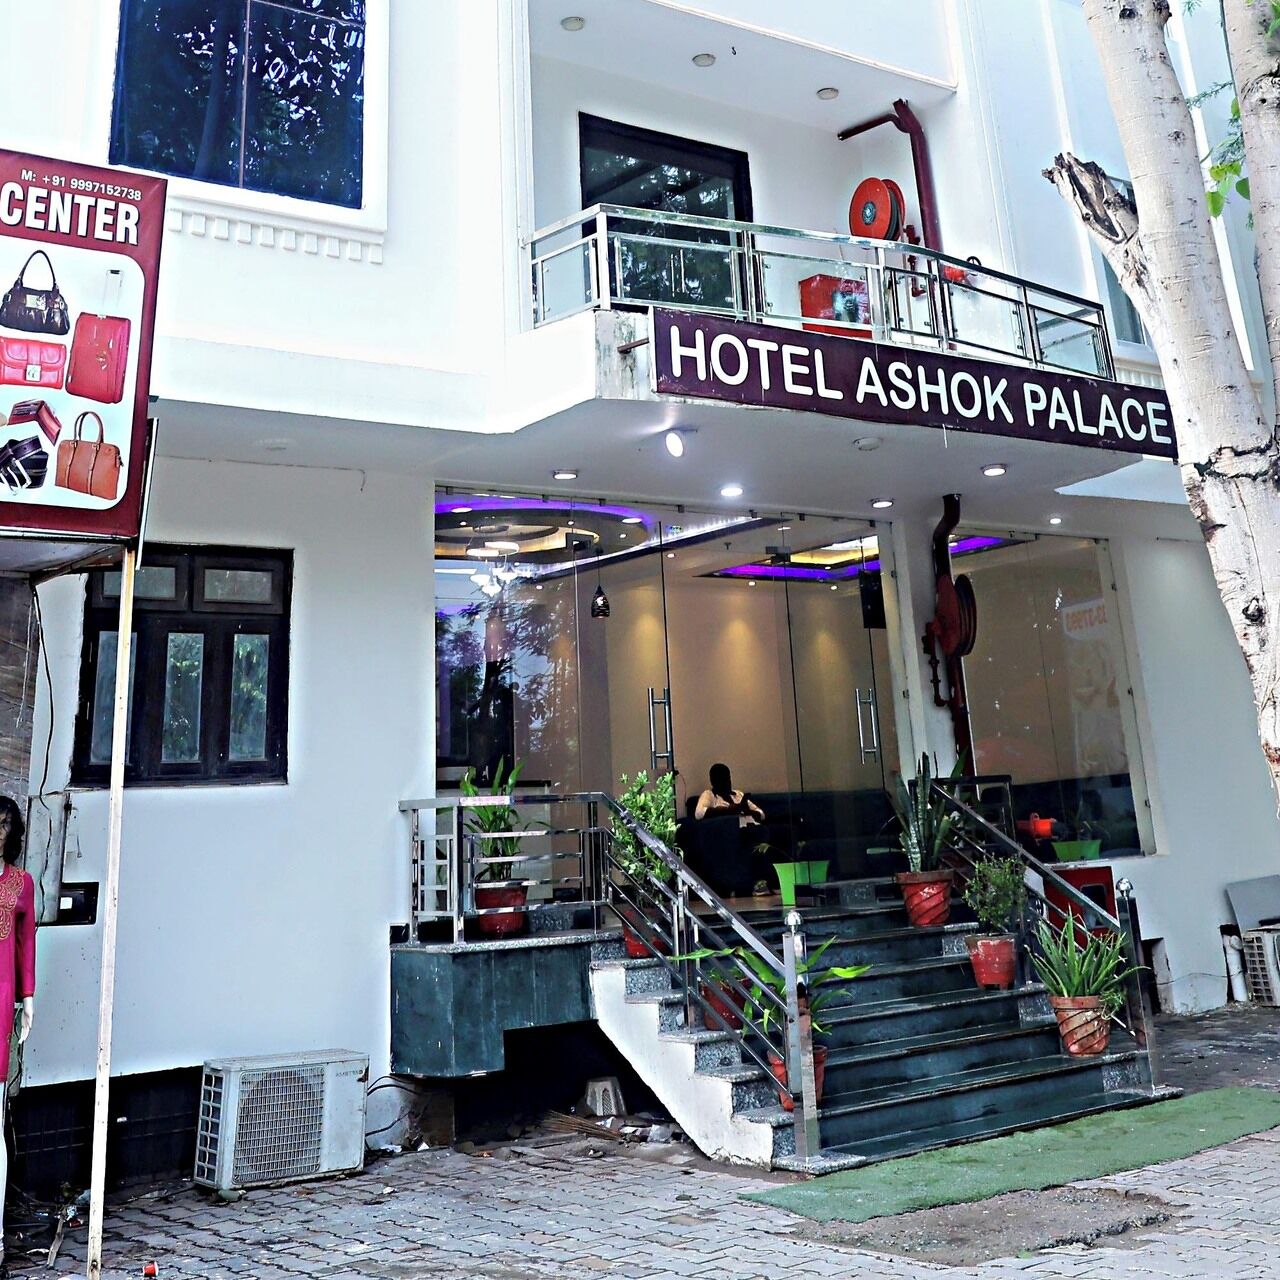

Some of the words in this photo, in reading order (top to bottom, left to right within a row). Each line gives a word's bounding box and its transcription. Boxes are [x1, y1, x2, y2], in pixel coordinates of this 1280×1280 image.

[20, 169, 37, 184] M:
[41, 172, 66, 189] +91
[69, 176, 143, 202] 9997152738
[669, 324, 844, 401] HOTEL
[855, 355, 1015, 425] ASHOK
[1022, 382, 1173, 445] PALACE
